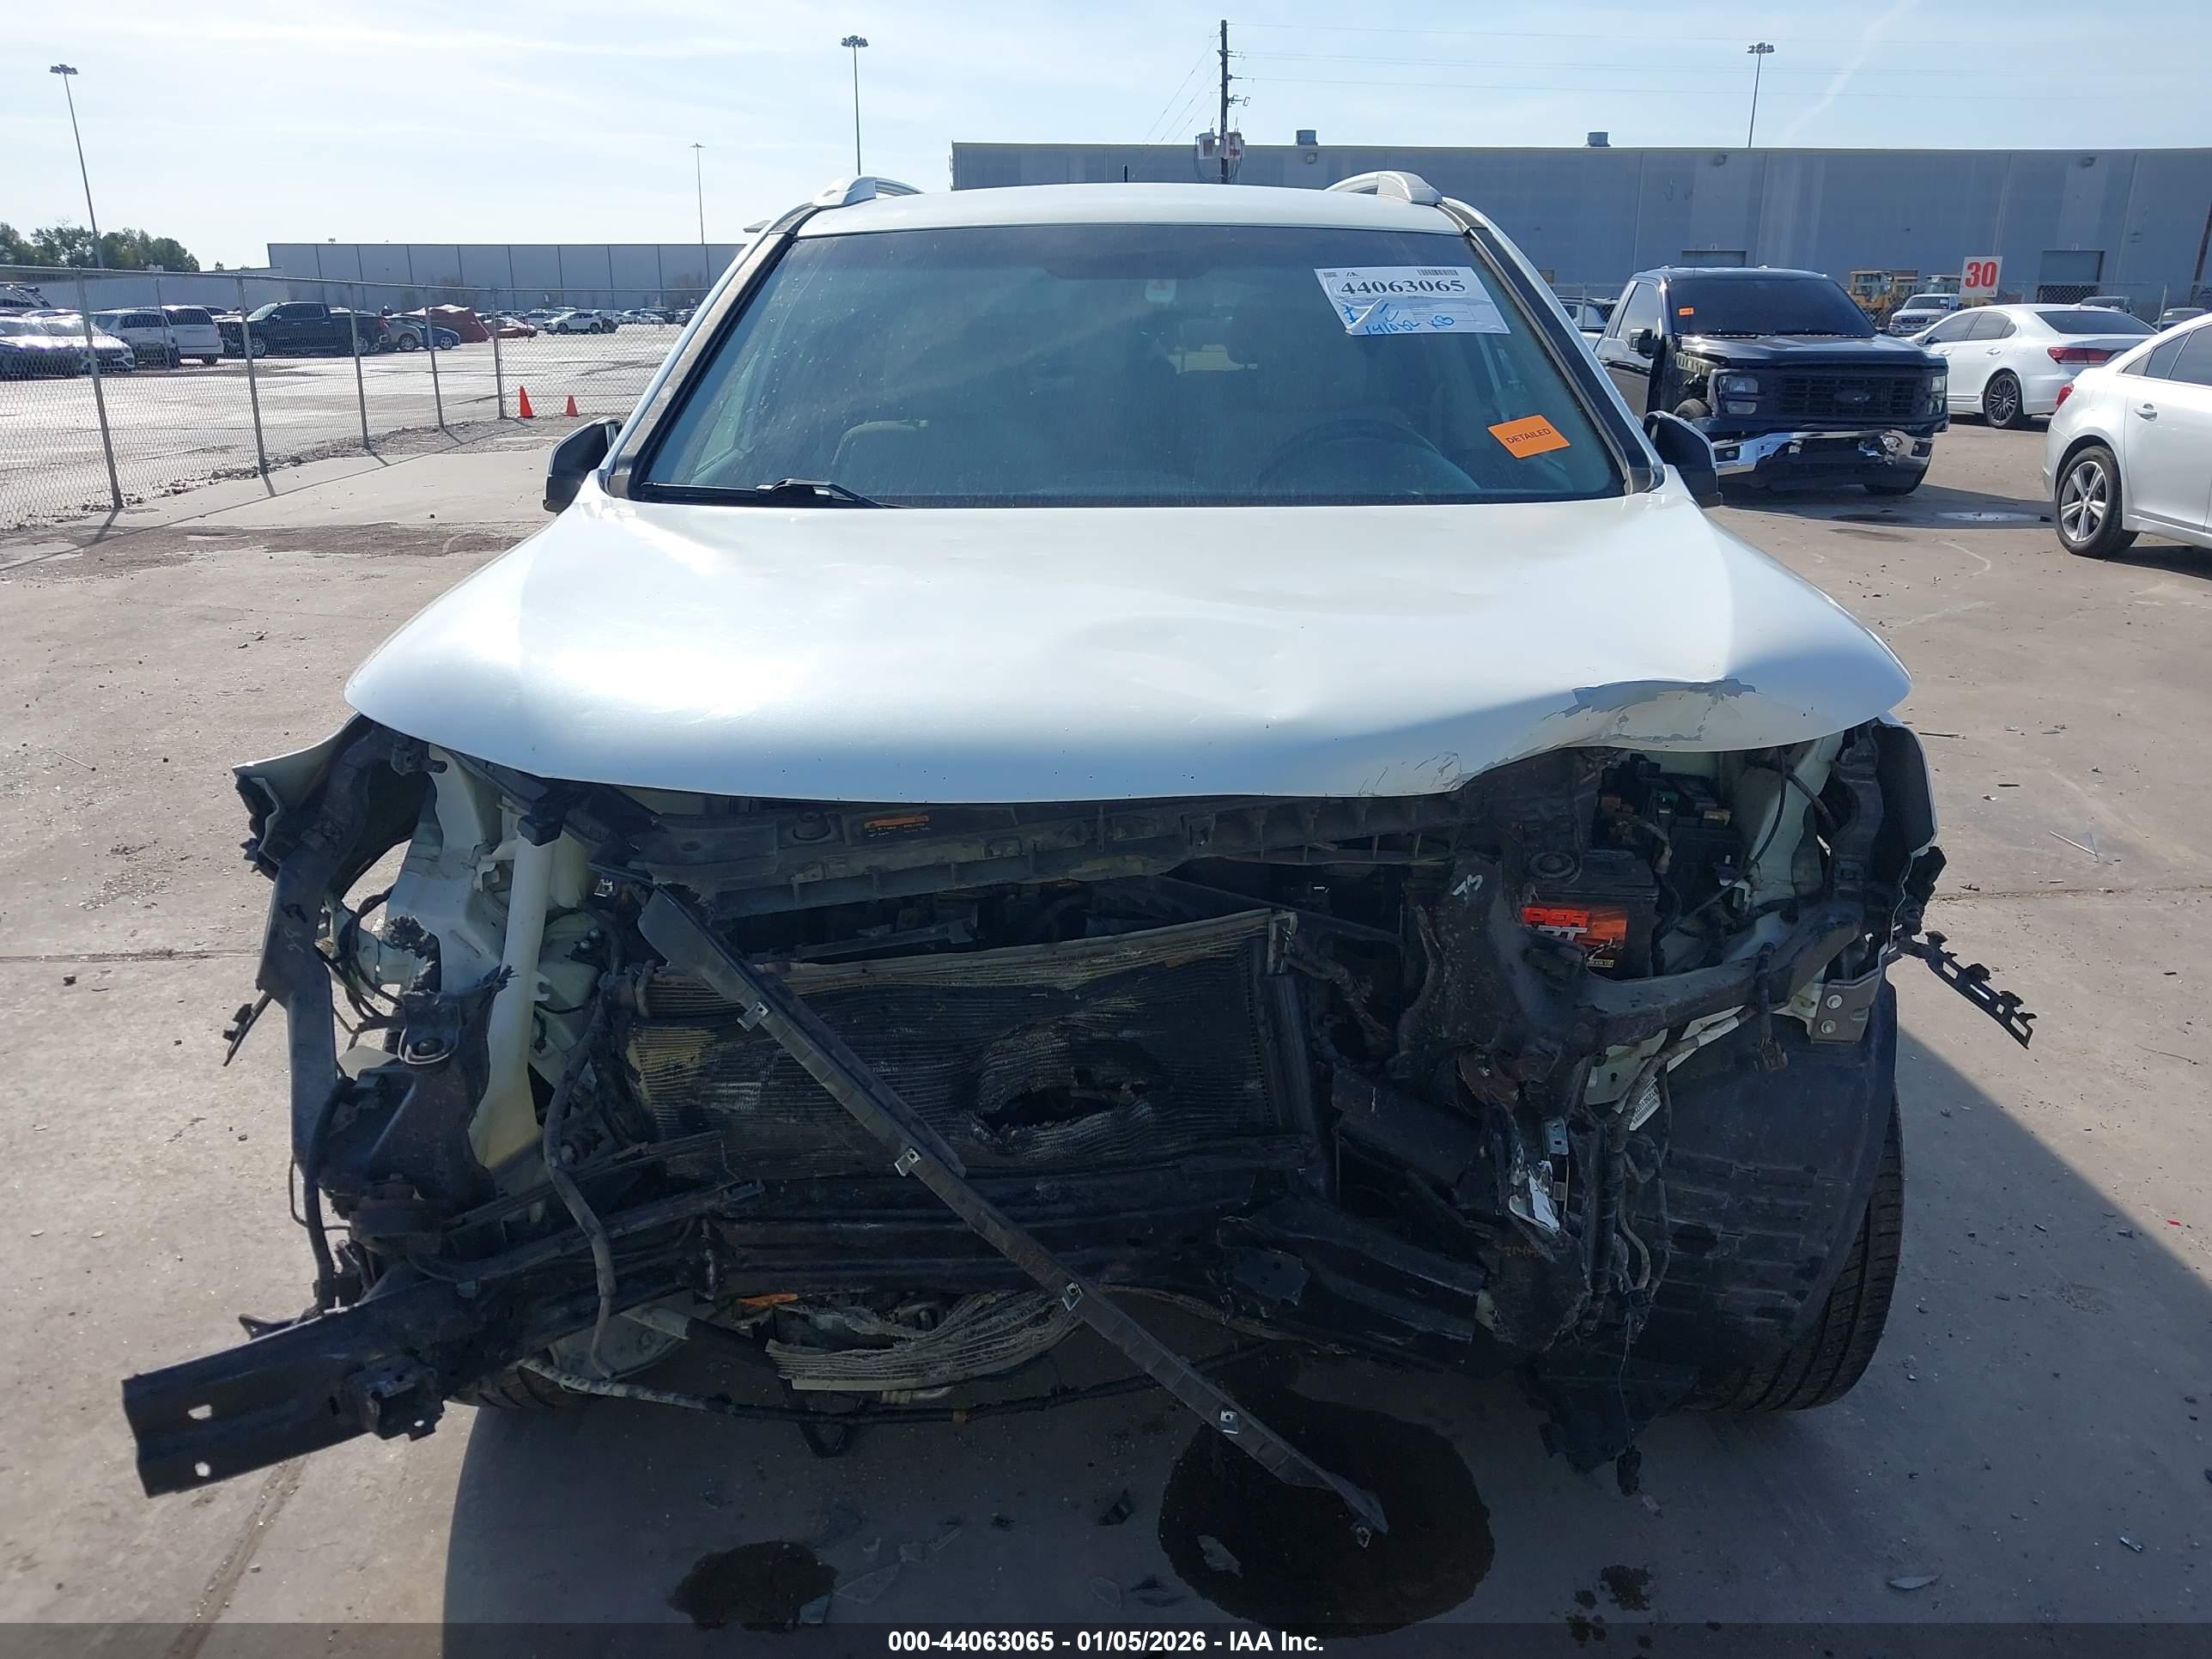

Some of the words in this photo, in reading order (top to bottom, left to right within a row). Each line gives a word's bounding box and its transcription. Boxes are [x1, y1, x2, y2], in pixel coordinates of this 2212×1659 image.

[1965, 261, 1997, 289] 30
[1340, 280, 1466, 295] 44063065
[1504, 428, 1552, 444] DETAILED
